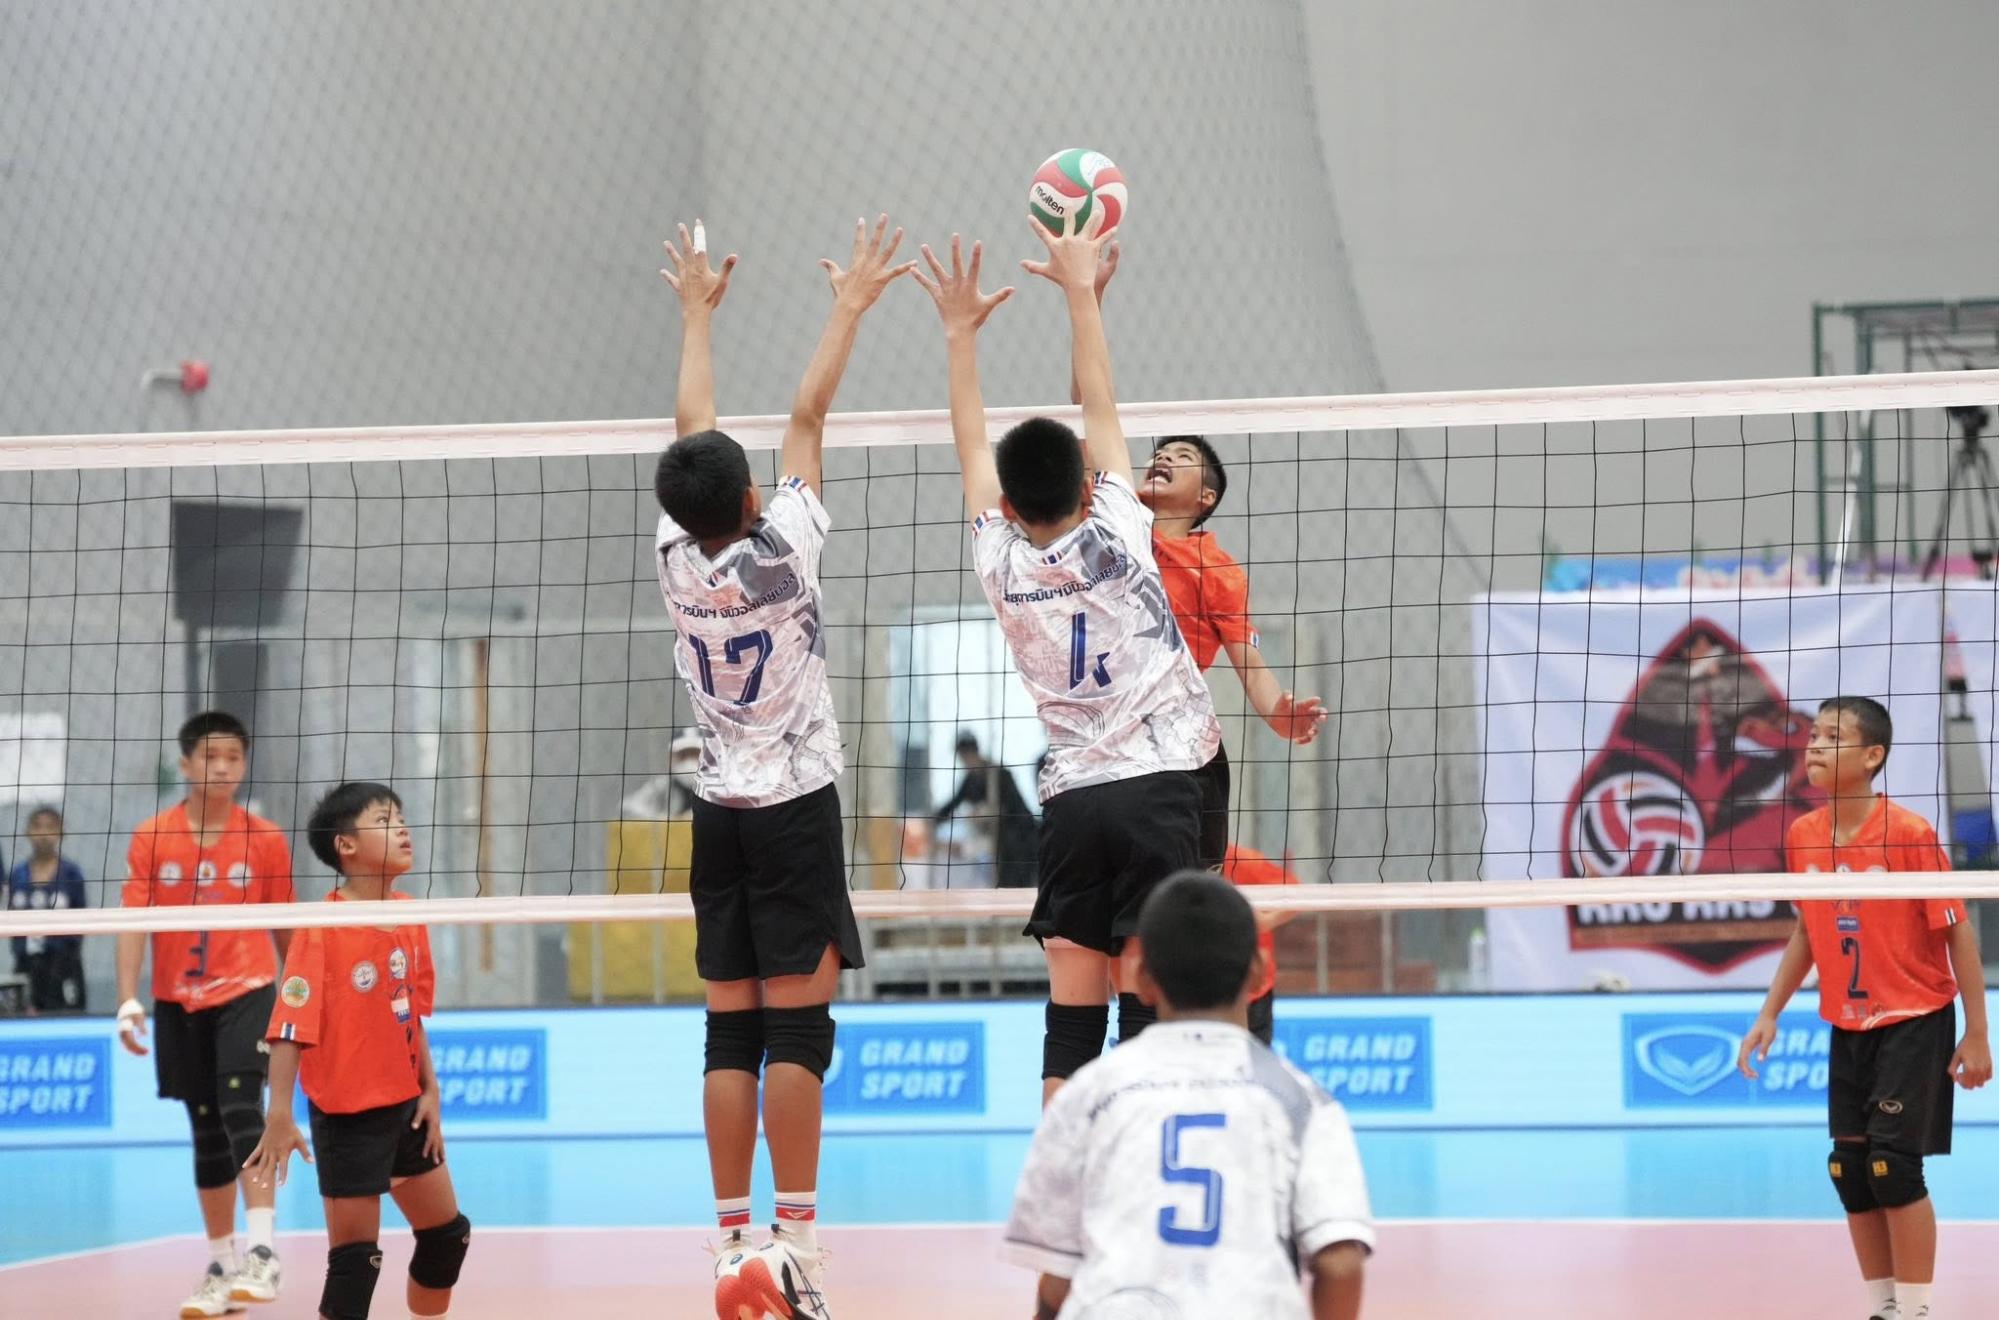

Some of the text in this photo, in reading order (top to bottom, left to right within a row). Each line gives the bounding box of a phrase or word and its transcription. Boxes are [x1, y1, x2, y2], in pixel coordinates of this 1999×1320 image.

[1034, 185, 1065, 215] molten
[688, 629, 774, 706] 17
[1841, 937, 1869, 999] 2
[860, 1038, 969, 1067] GRAND
[1303, 1034, 1416, 1062] GRAND
[1767, 1029, 1831, 1056] GRA
[439, 1076, 527, 1106] PORT
[860, 1070, 967, 1100] SPORT
[1764, 1061, 1829, 1091] SPO
[1158, 1113, 1227, 1248] 5
